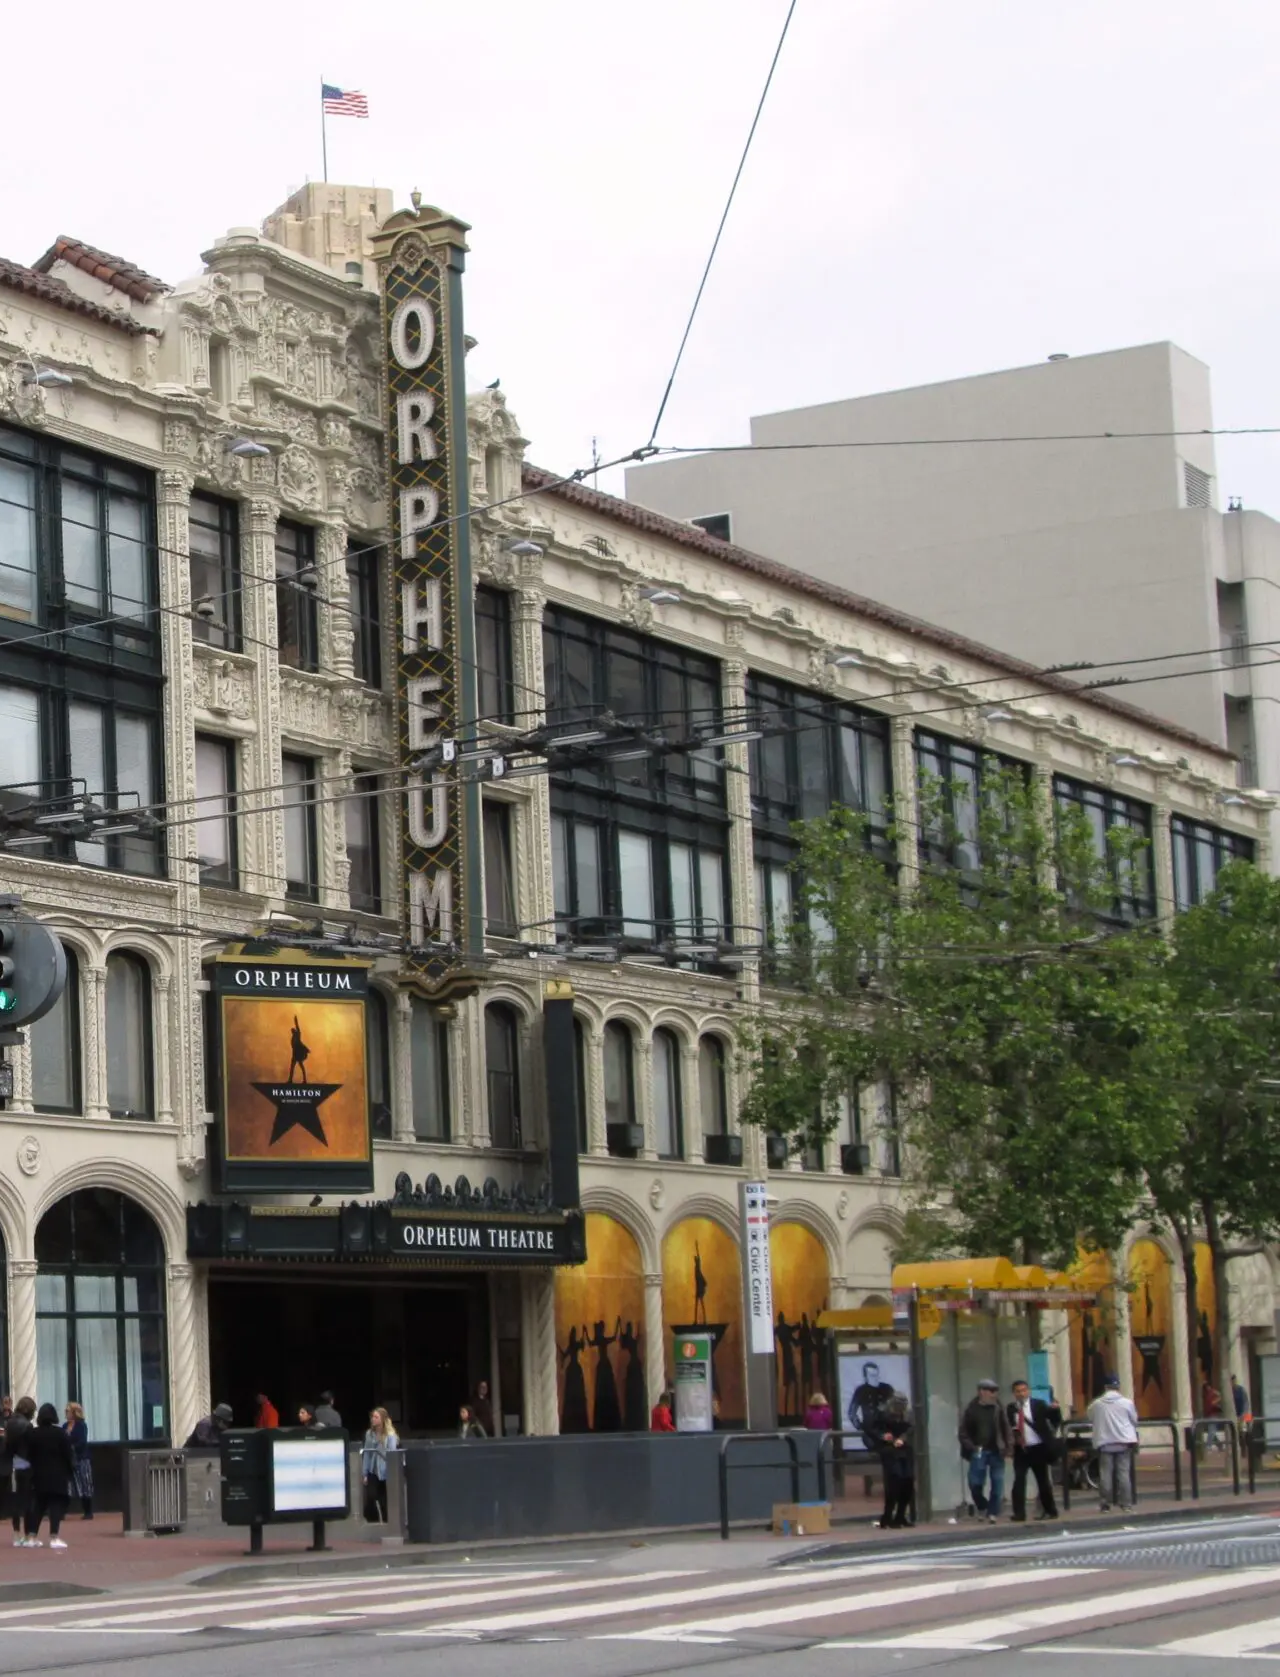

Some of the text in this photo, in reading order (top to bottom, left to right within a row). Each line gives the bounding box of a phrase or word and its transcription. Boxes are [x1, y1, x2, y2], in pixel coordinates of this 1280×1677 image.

[390, 297, 454, 946] ORPHEUM
[235, 969, 352, 990] ORPHEUM
[272, 1089, 321, 1097] HAMILTON
[403, 1225, 554, 1249] ORPHEUM THEATRE
[751, 1246, 761, 1317] Civic Center
